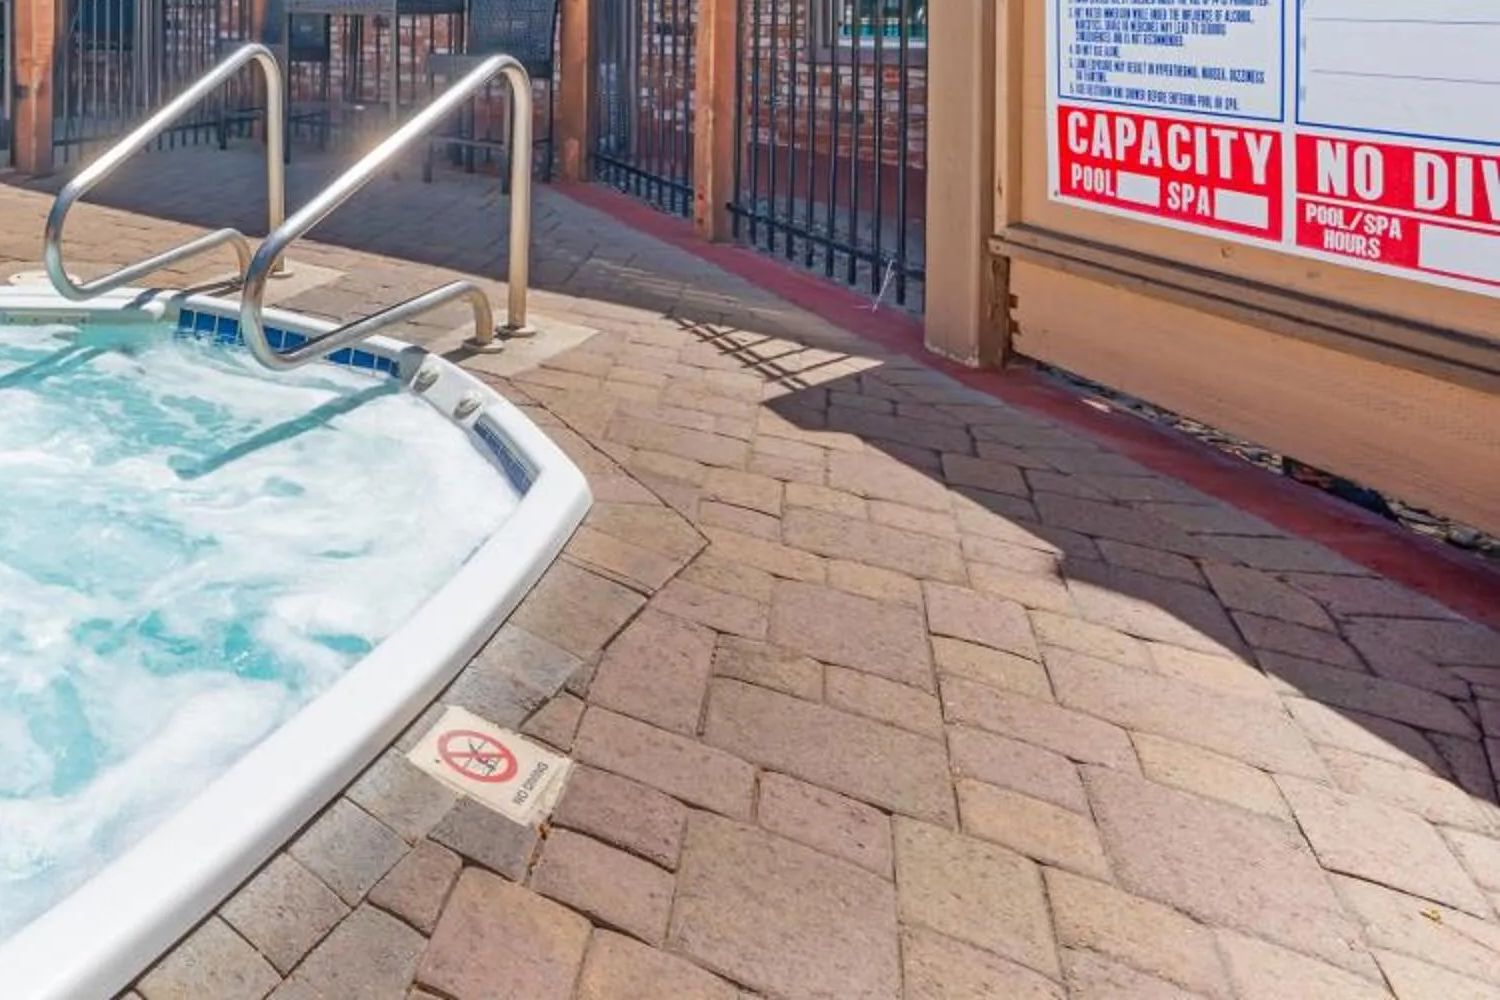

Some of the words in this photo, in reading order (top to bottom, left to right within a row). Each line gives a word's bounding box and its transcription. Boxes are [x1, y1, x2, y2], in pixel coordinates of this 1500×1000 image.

[1067, 110, 1273, 186] CAPACITY
[1071, 163, 1115, 197] POOL
[1316, 140, 1384, 201] NO
[1167, 181, 1212, 217] SPA
[1305, 202, 1403, 241] POOL/SPA
[1324, 229, 1381, 259] HOURS
